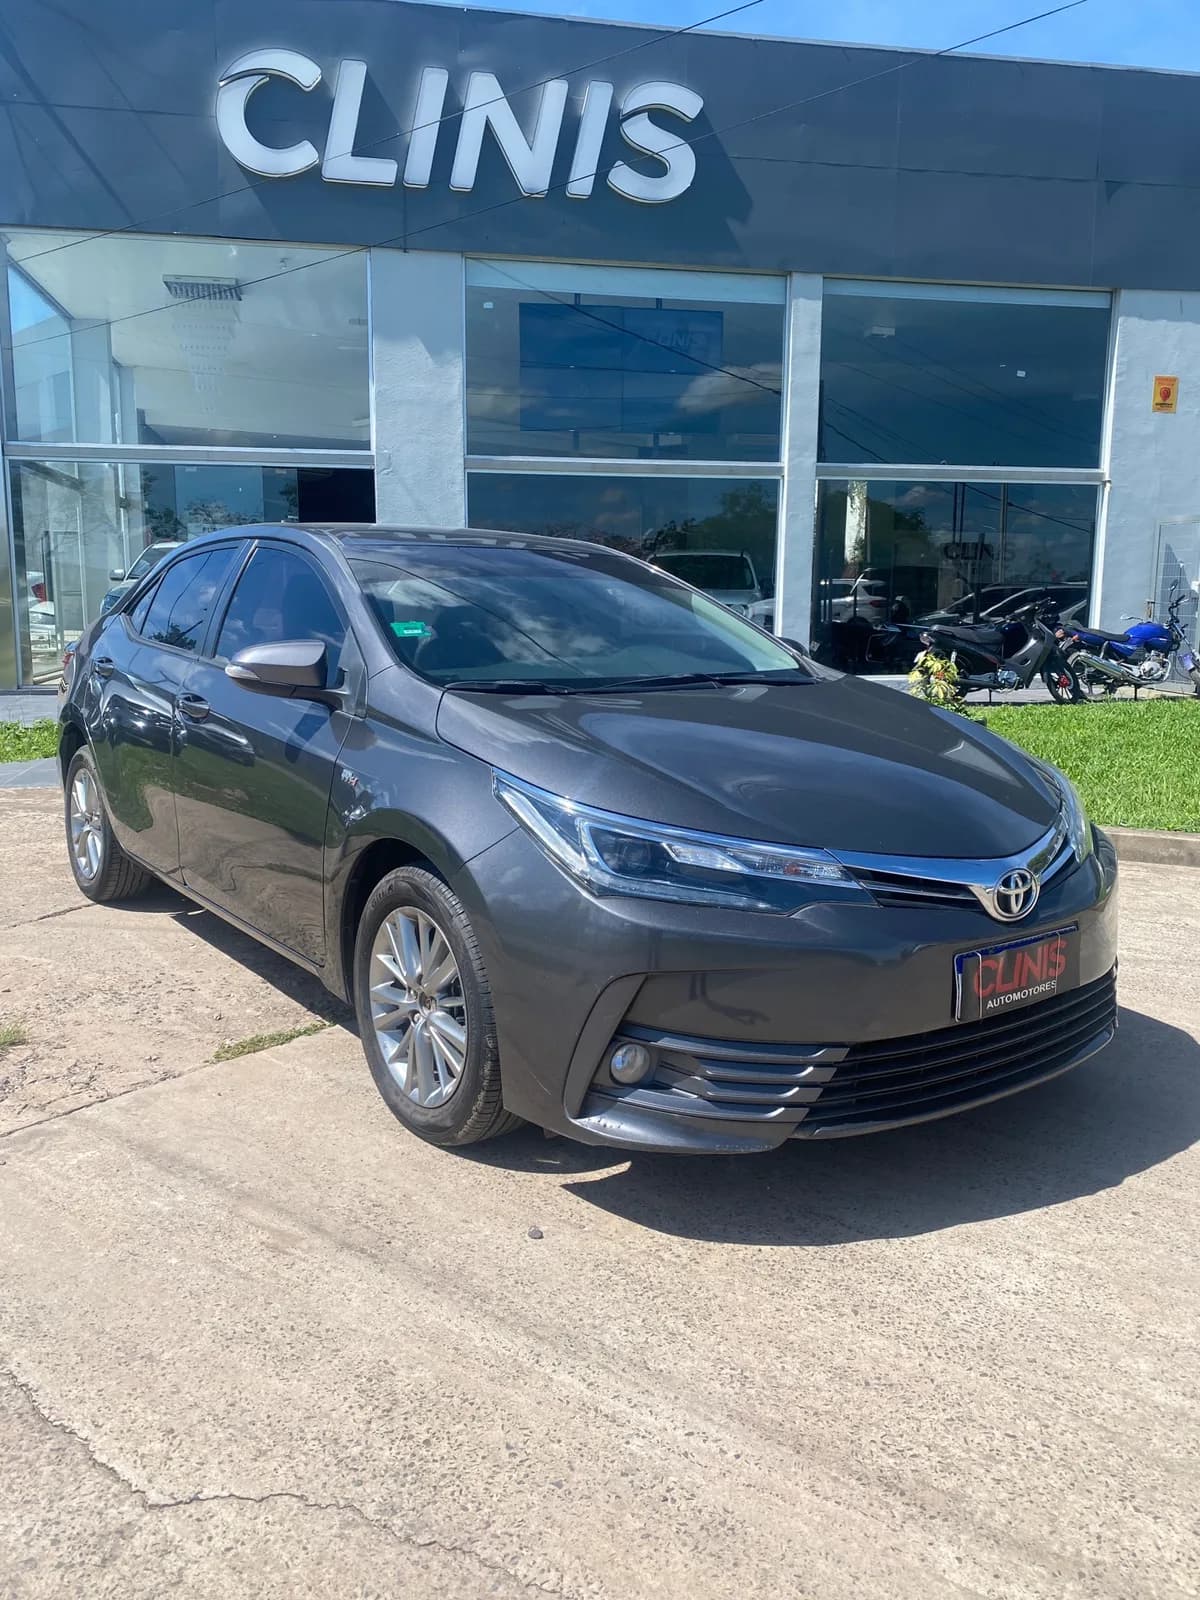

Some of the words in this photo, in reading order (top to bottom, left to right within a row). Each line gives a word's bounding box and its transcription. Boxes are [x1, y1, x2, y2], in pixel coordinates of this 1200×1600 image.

[214, 48, 703, 204] CLINIS
[974, 938, 1067, 997] CLINIS
[986, 980, 1056, 1009] AUTOMOTORES
